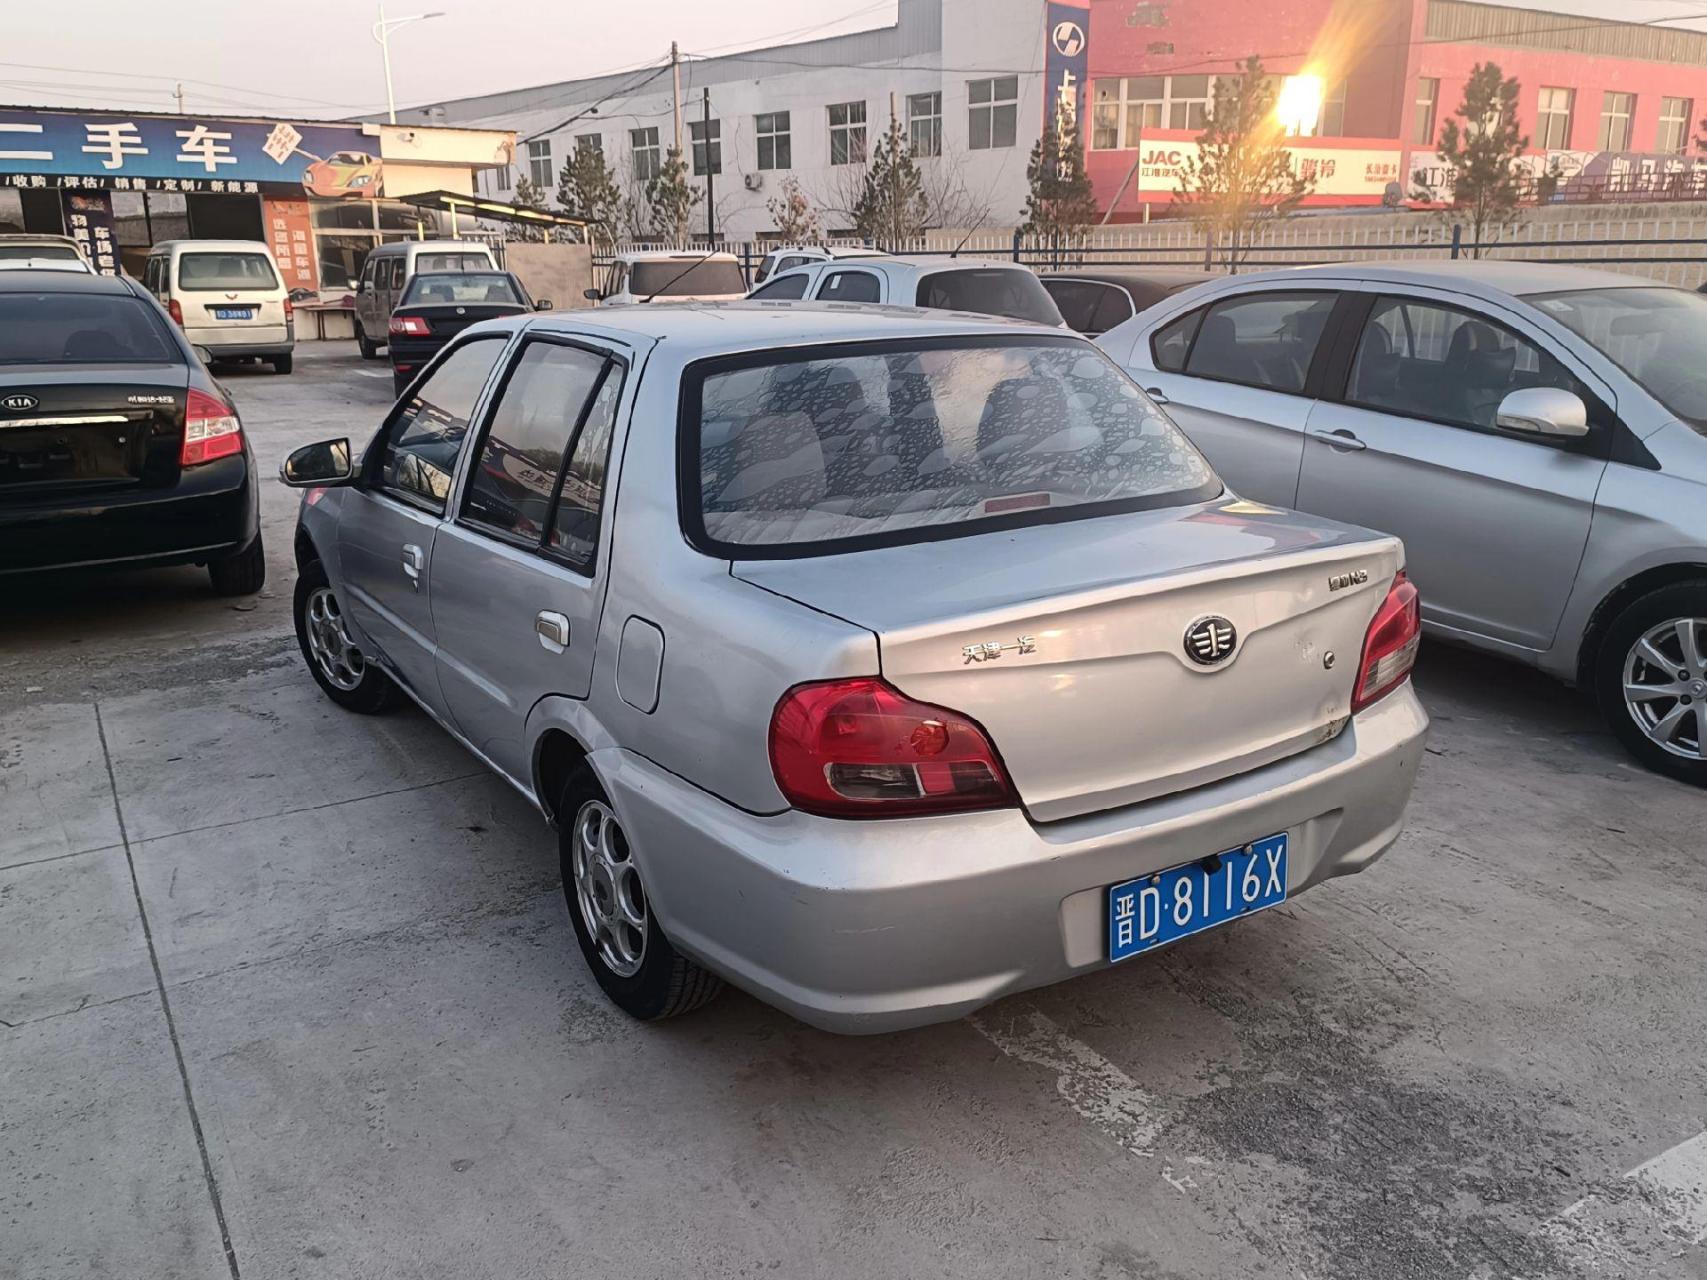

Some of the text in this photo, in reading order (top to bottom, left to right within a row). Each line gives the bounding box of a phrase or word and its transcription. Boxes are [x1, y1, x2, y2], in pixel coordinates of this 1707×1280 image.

[0, 122, 238, 172] 二手车
[1142, 150, 1182, 166] JAC
[8, 397, 32, 407] KIA
